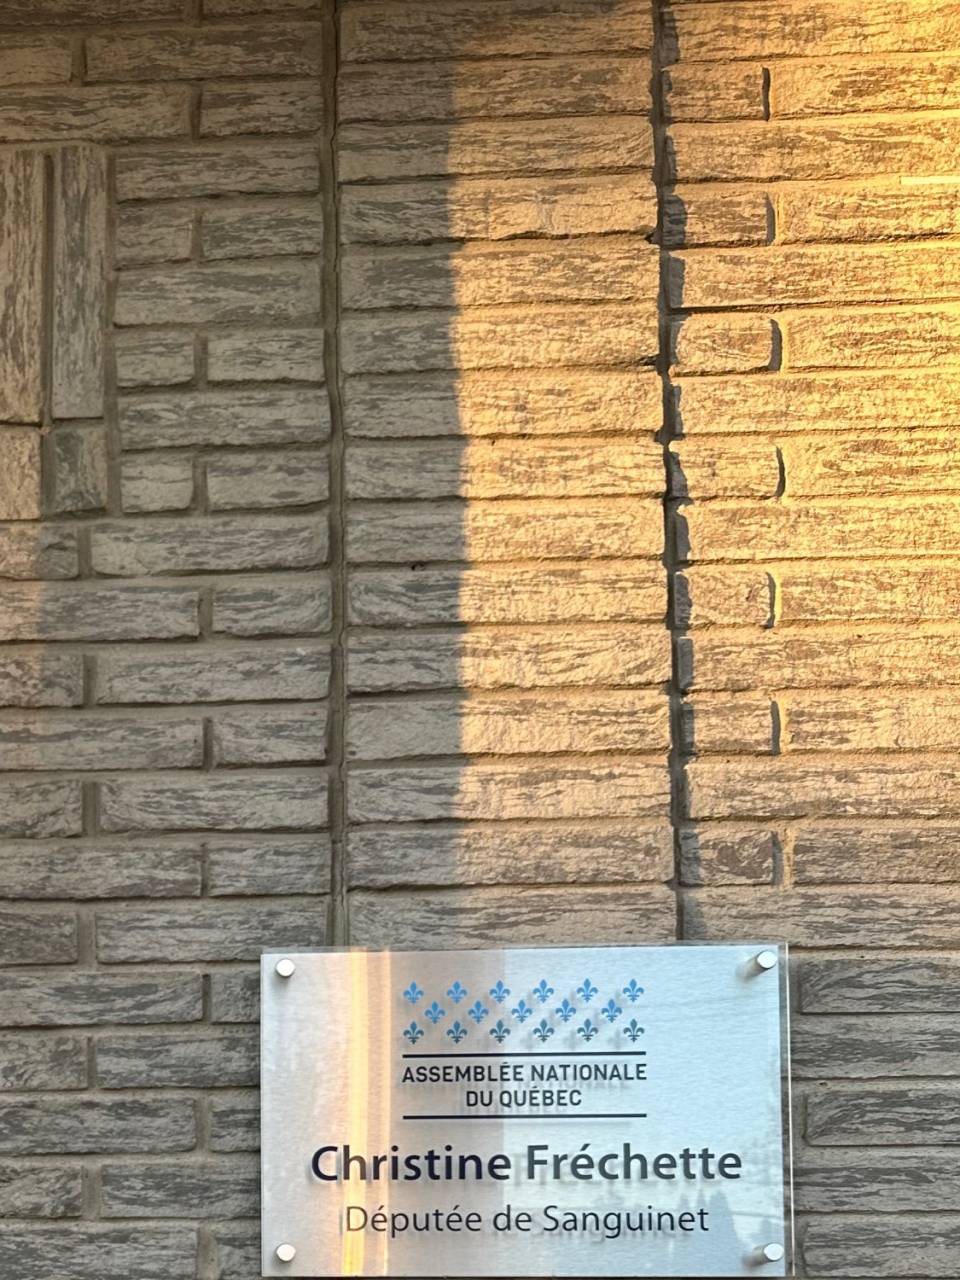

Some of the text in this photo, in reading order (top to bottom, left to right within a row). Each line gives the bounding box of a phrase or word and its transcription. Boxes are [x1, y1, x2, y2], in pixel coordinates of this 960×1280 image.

[401, 1062, 648, 1083] ASSEMBLÉE NATIONALE
[466, 1087, 582, 1107] DU QUÉBEC
[311, 1143, 742, 1181] Christine Fréchette
[345, 1205, 709, 1238] Députée de Sanguinet
